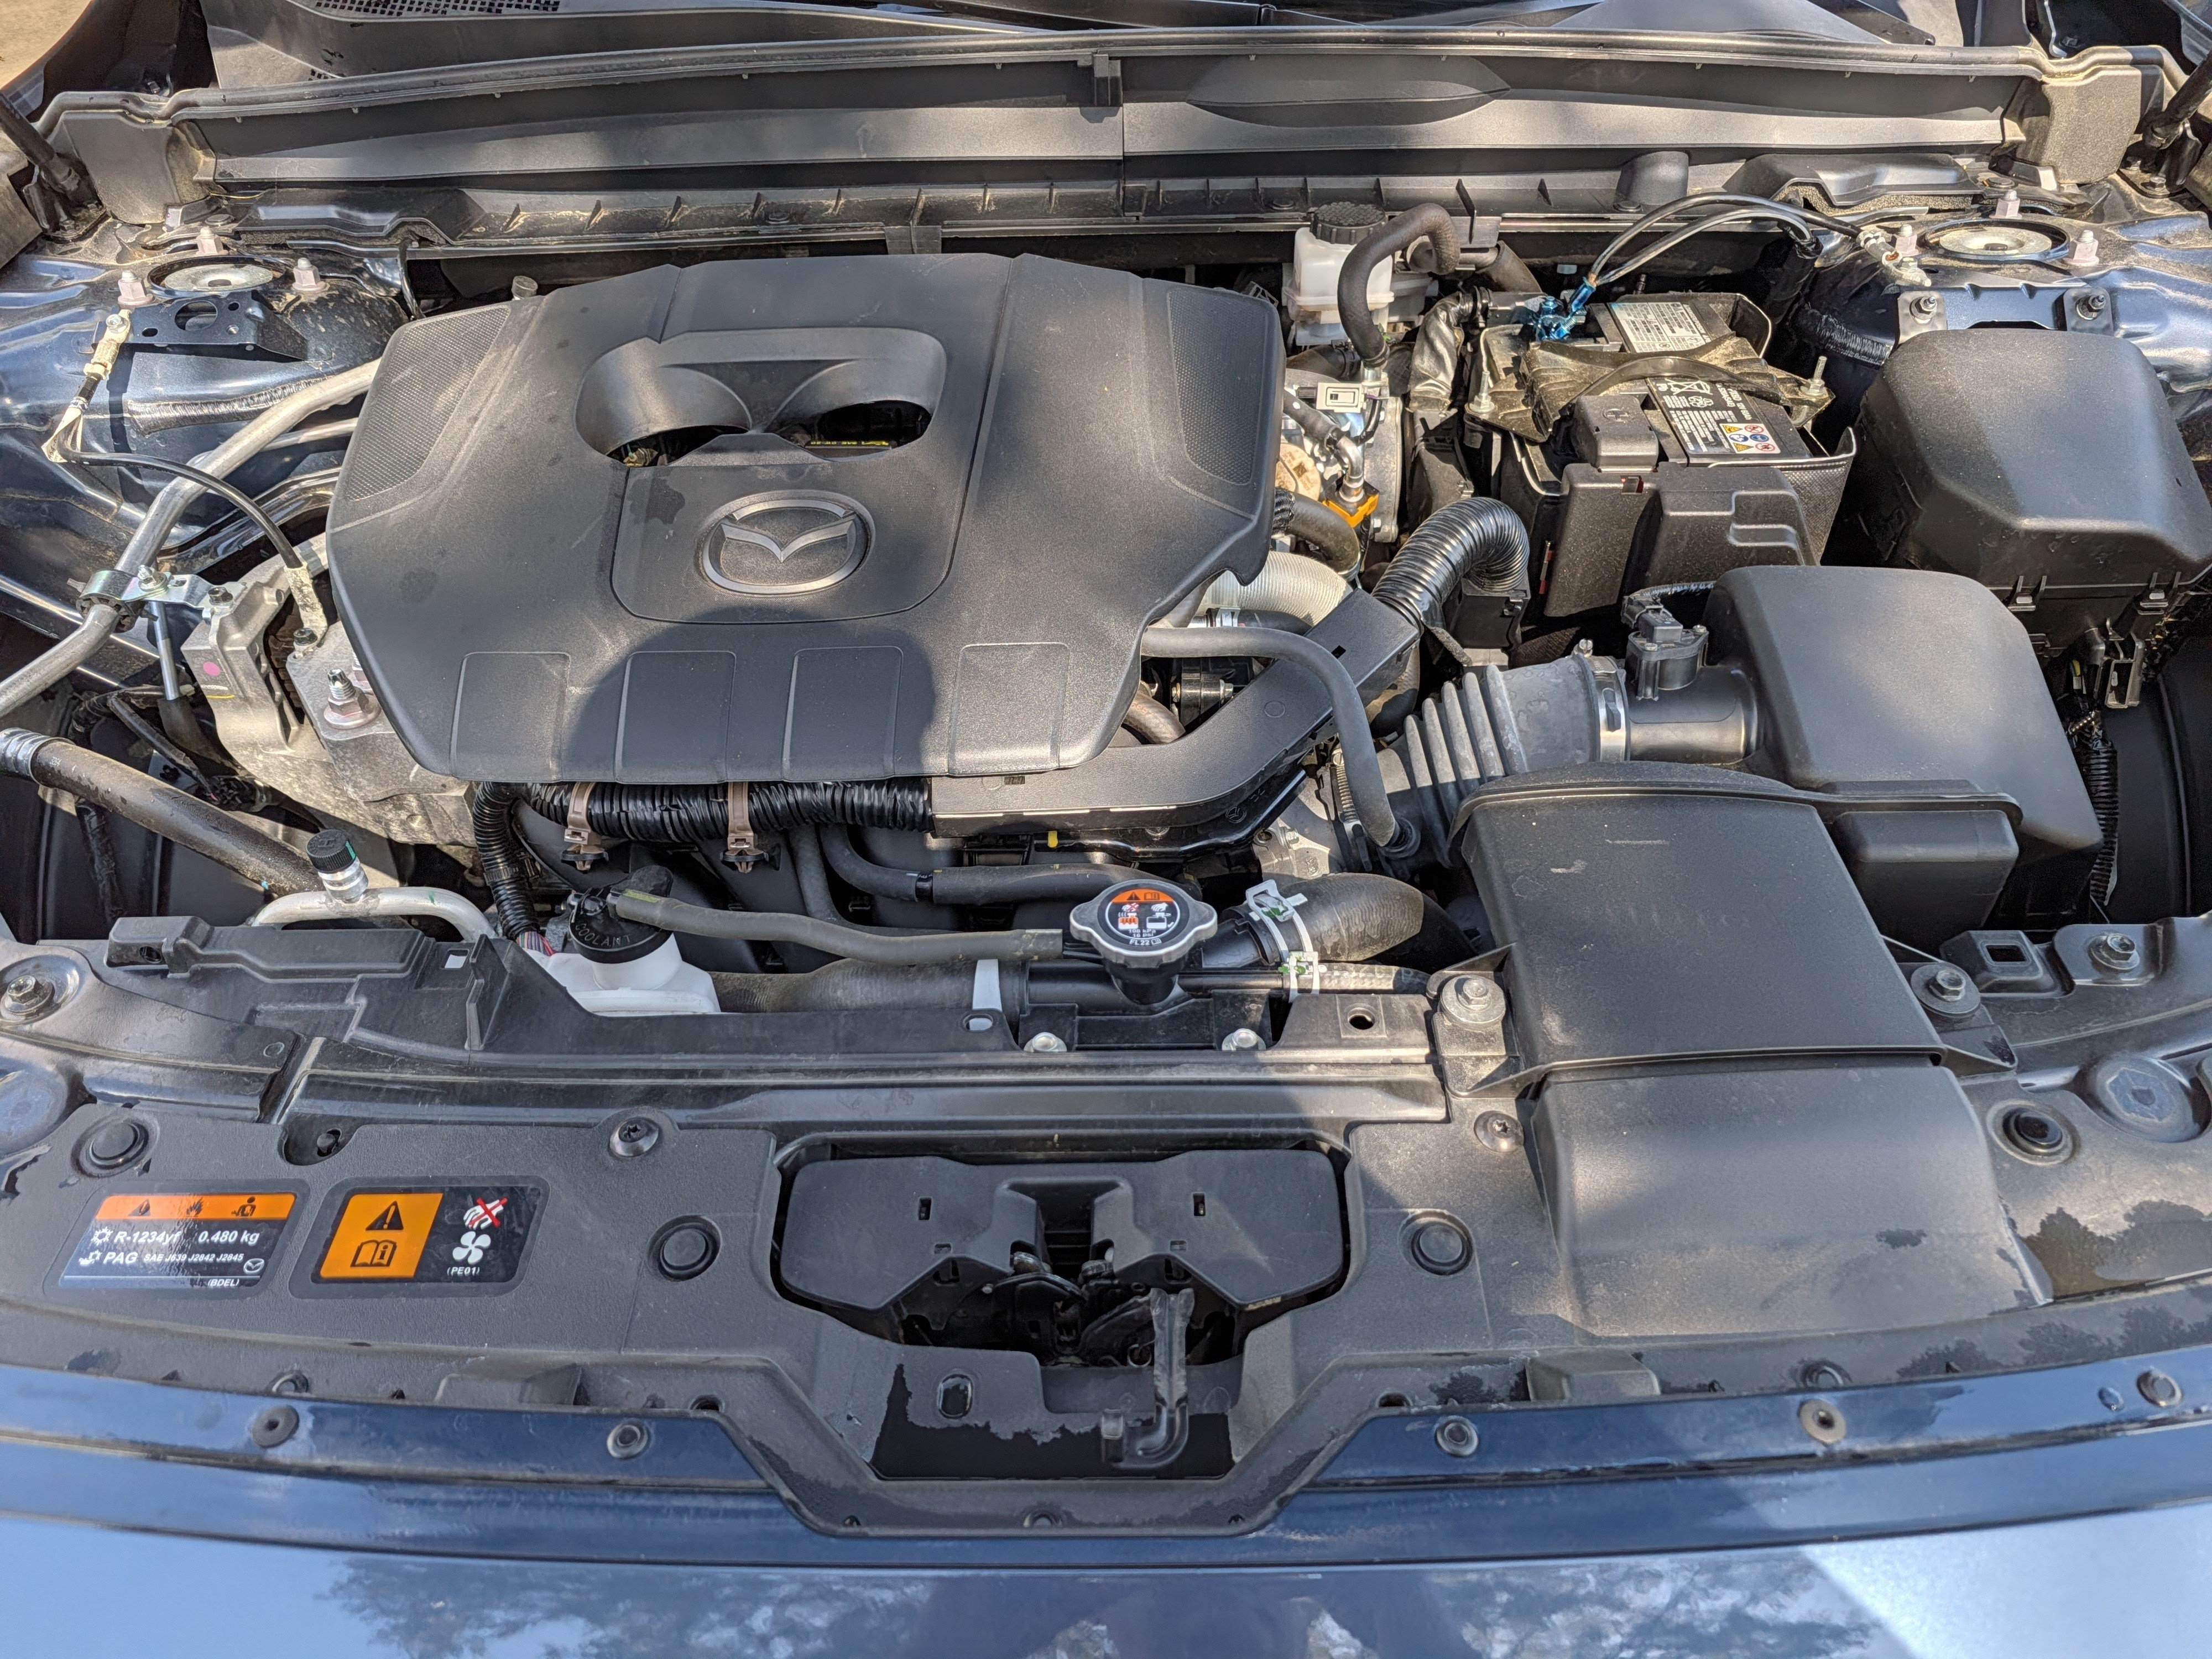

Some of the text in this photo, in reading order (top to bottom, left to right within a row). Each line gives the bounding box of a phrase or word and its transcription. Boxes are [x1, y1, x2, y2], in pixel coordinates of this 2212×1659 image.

[575, 923, 630, 947] COOLANT
[113, 1230, 260, 1245] R-1234yf 0.480 kg
[103, 1251, 244, 1264] PAG SAE J639 J2842 J2845
[447, 1266, 480, 1276] (PE01)
[207, 1279, 240, 1287] (BDEL)
